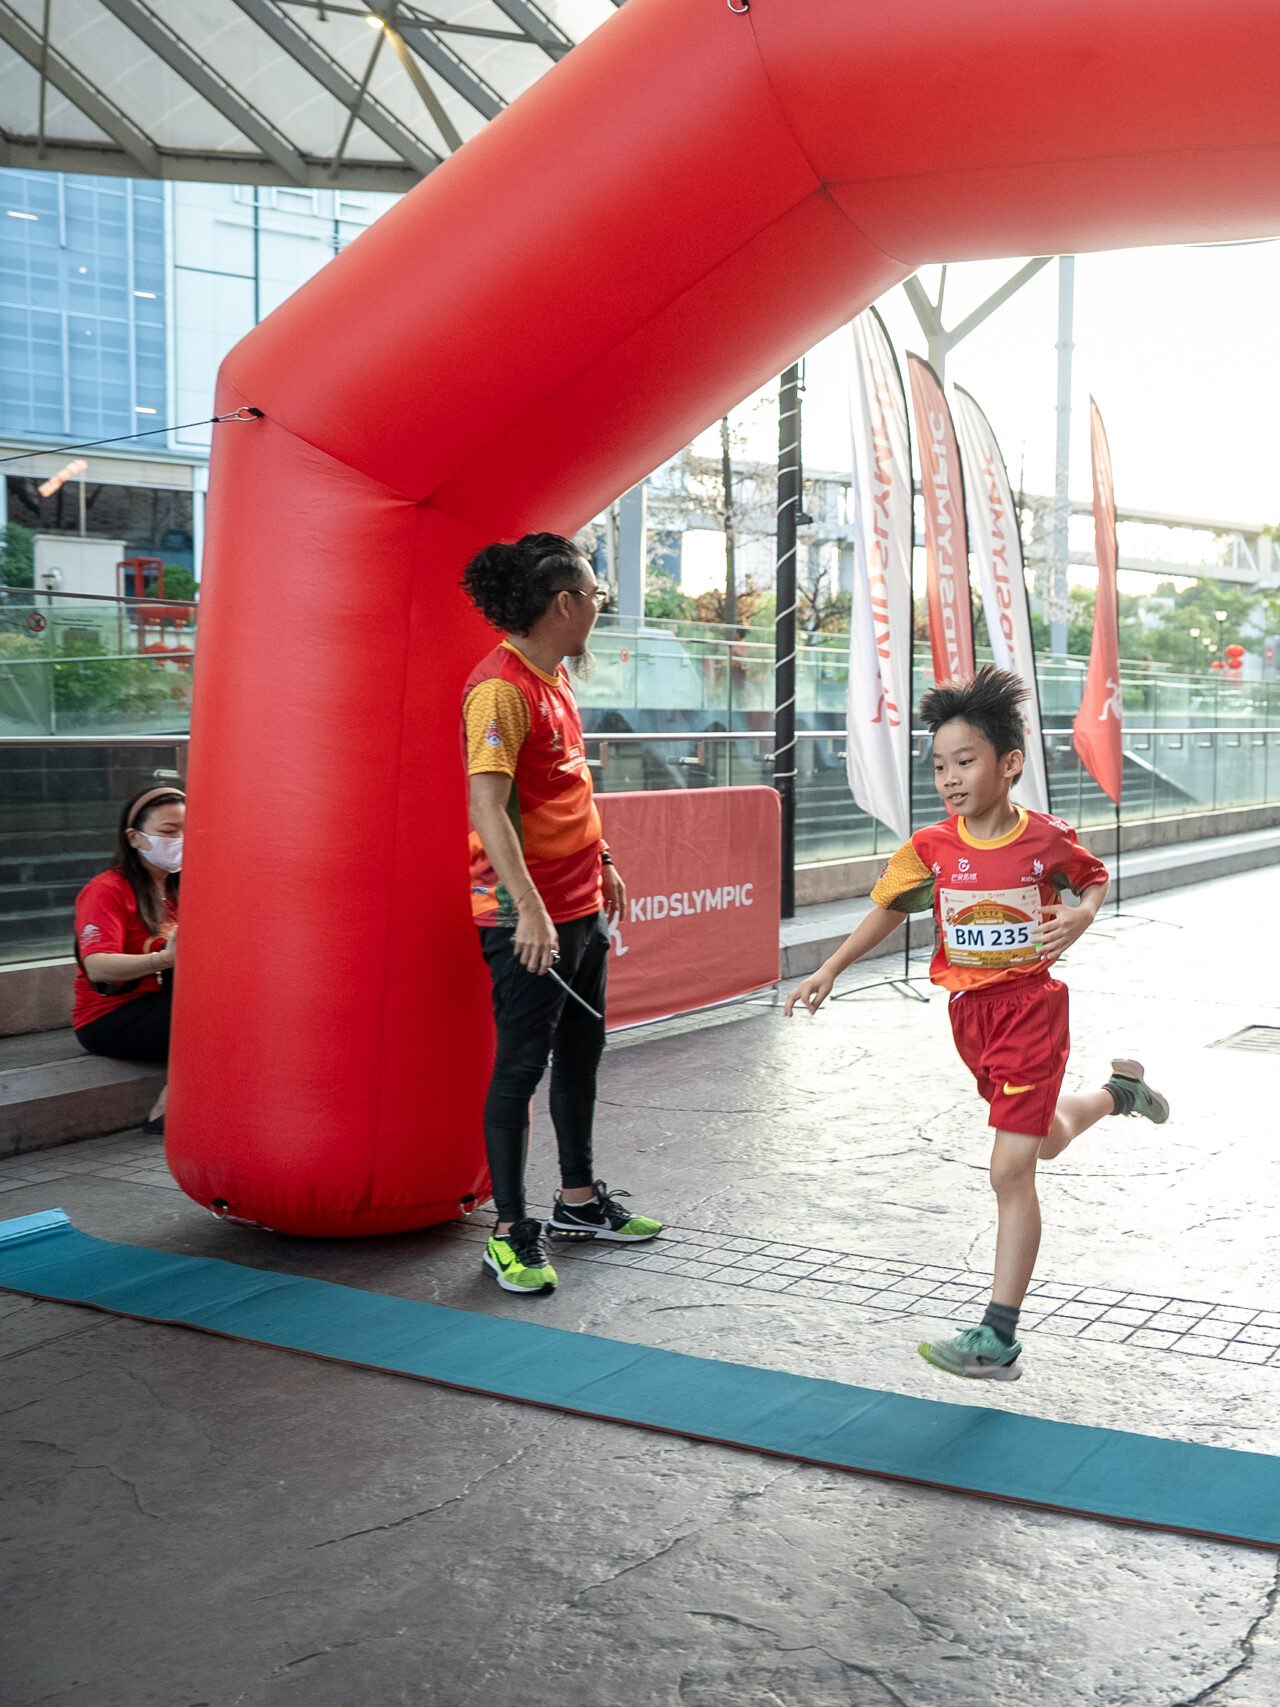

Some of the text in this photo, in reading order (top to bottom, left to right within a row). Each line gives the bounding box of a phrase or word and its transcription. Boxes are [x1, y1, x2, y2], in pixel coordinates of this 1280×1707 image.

[630, 883, 753, 923] KIDSLYMPIC
[955, 926, 1029, 947] BM 235
